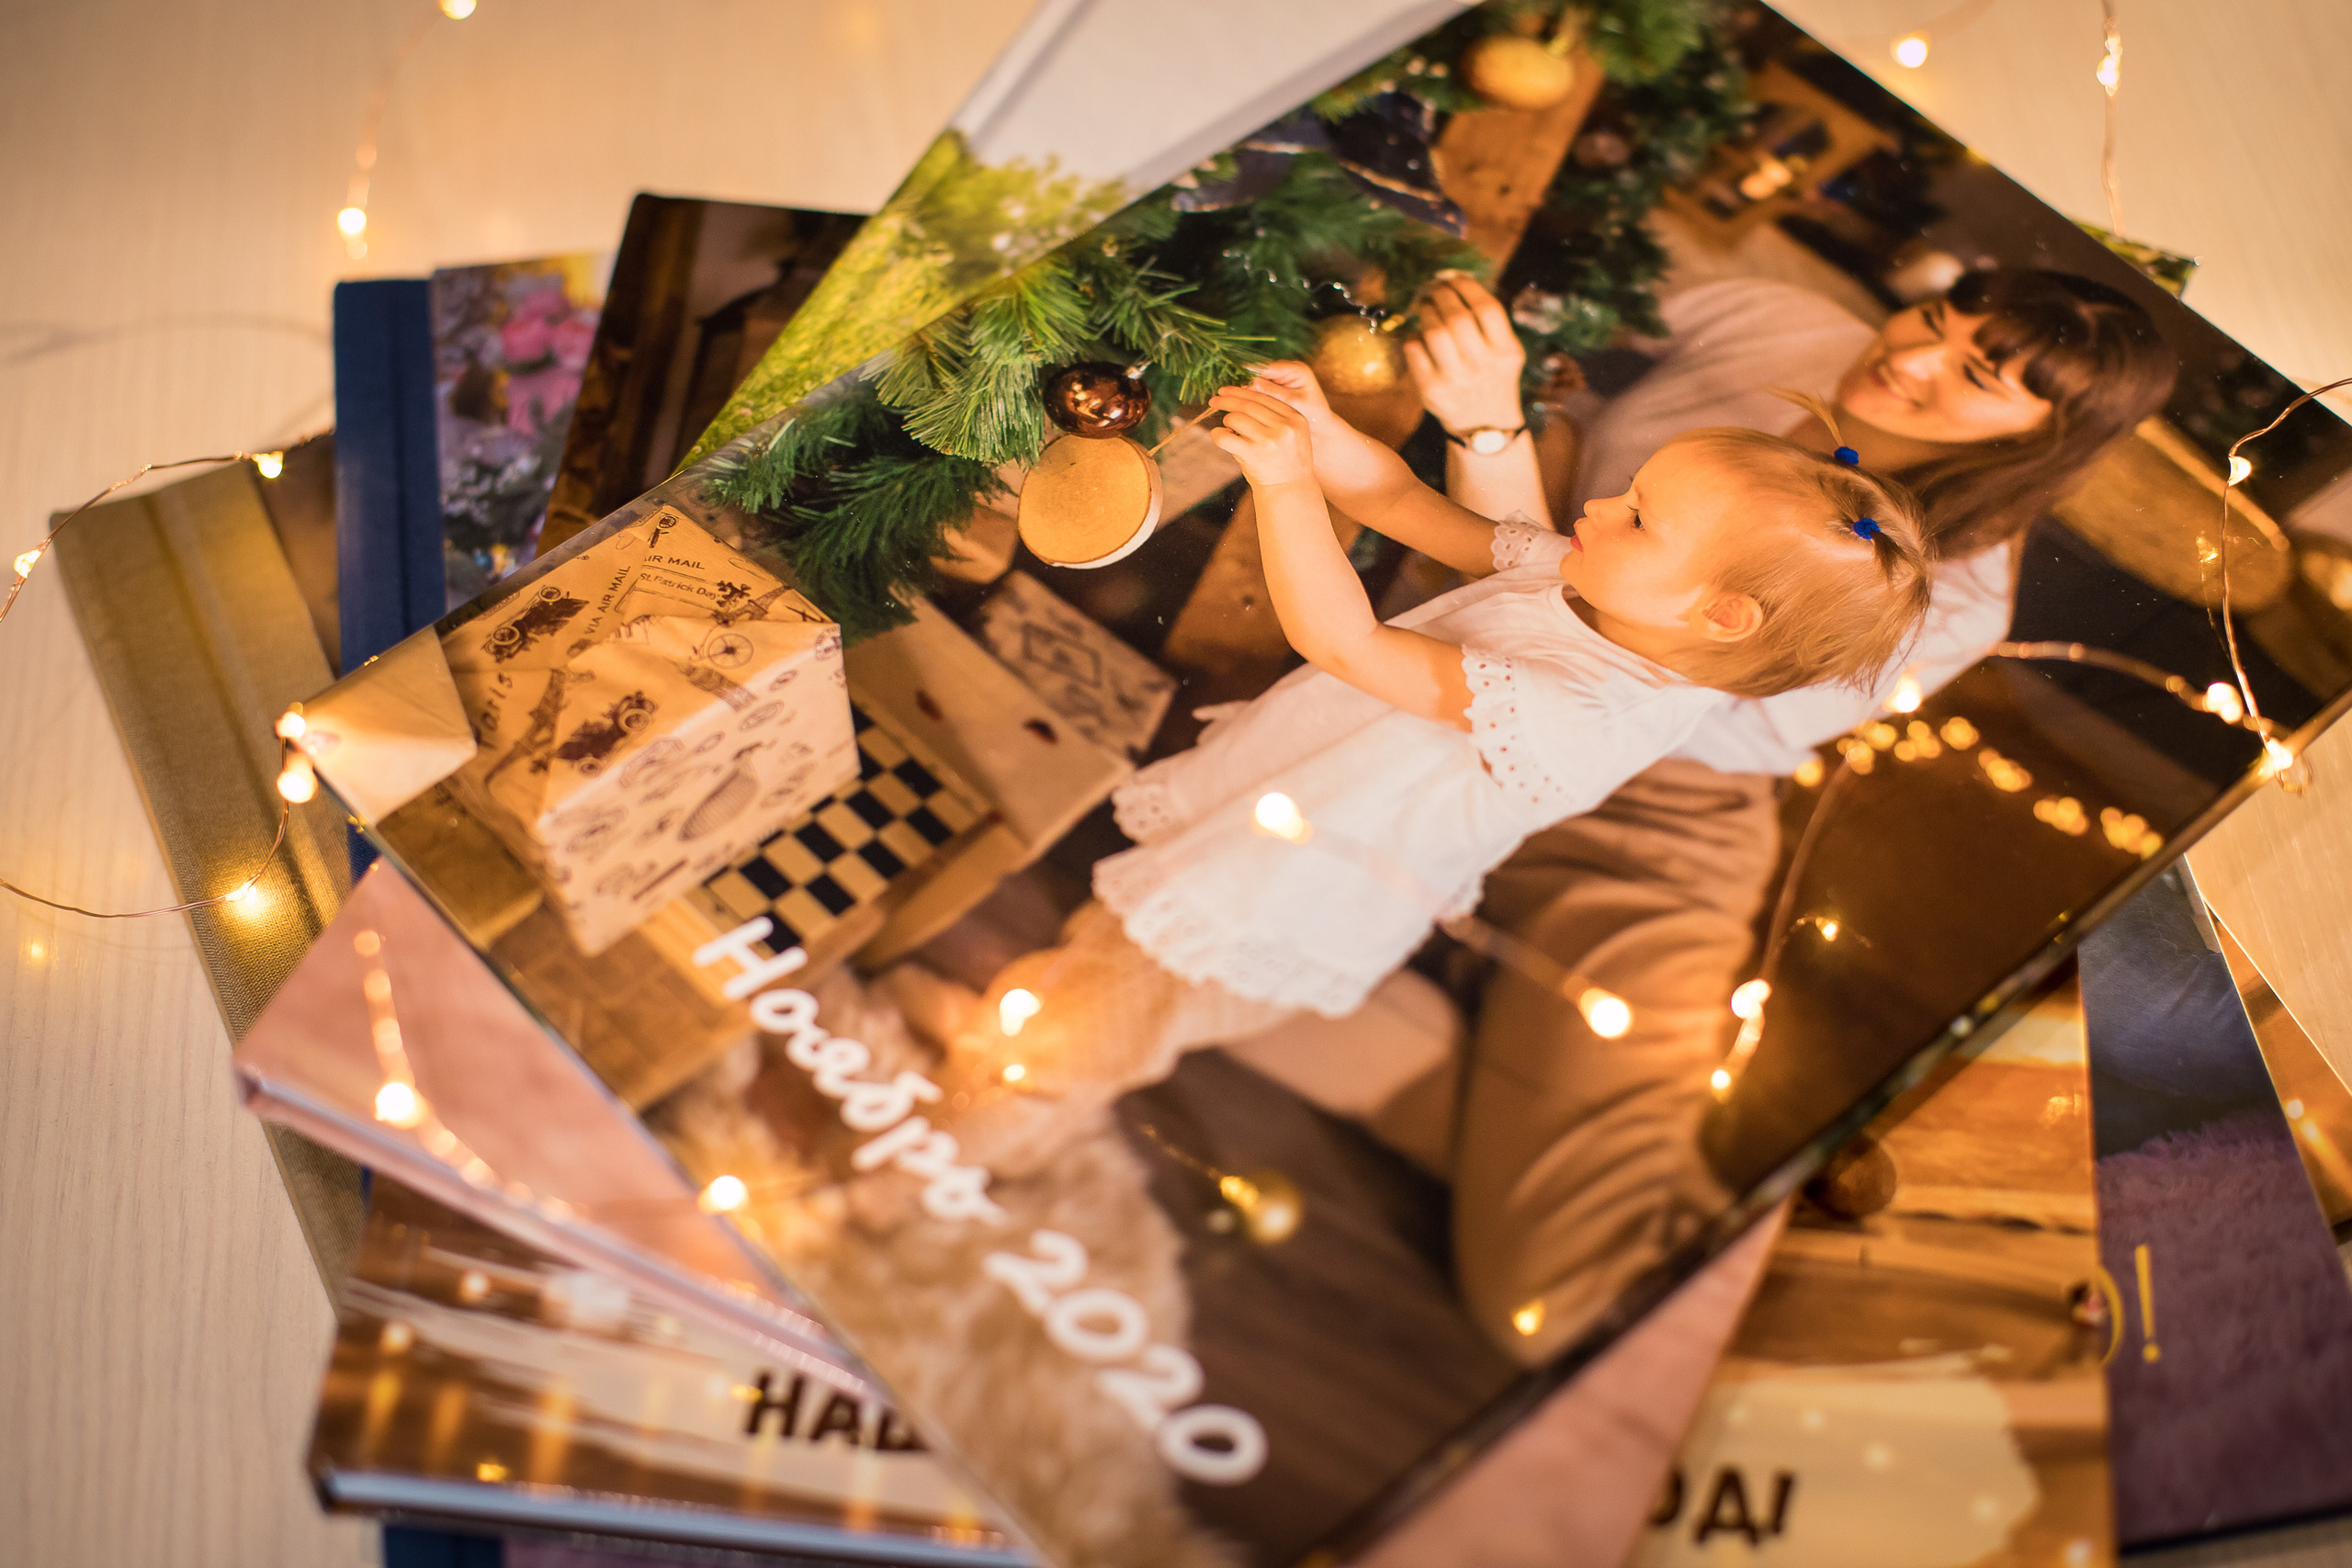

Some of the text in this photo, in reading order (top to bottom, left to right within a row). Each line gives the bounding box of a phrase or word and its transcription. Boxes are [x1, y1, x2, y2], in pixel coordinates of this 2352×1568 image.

[668, 558, 705, 570] MAIL
[584, 566, 631, 634] VIA AIR MAIL
[983, 1228, 1270, 1487] 2020
